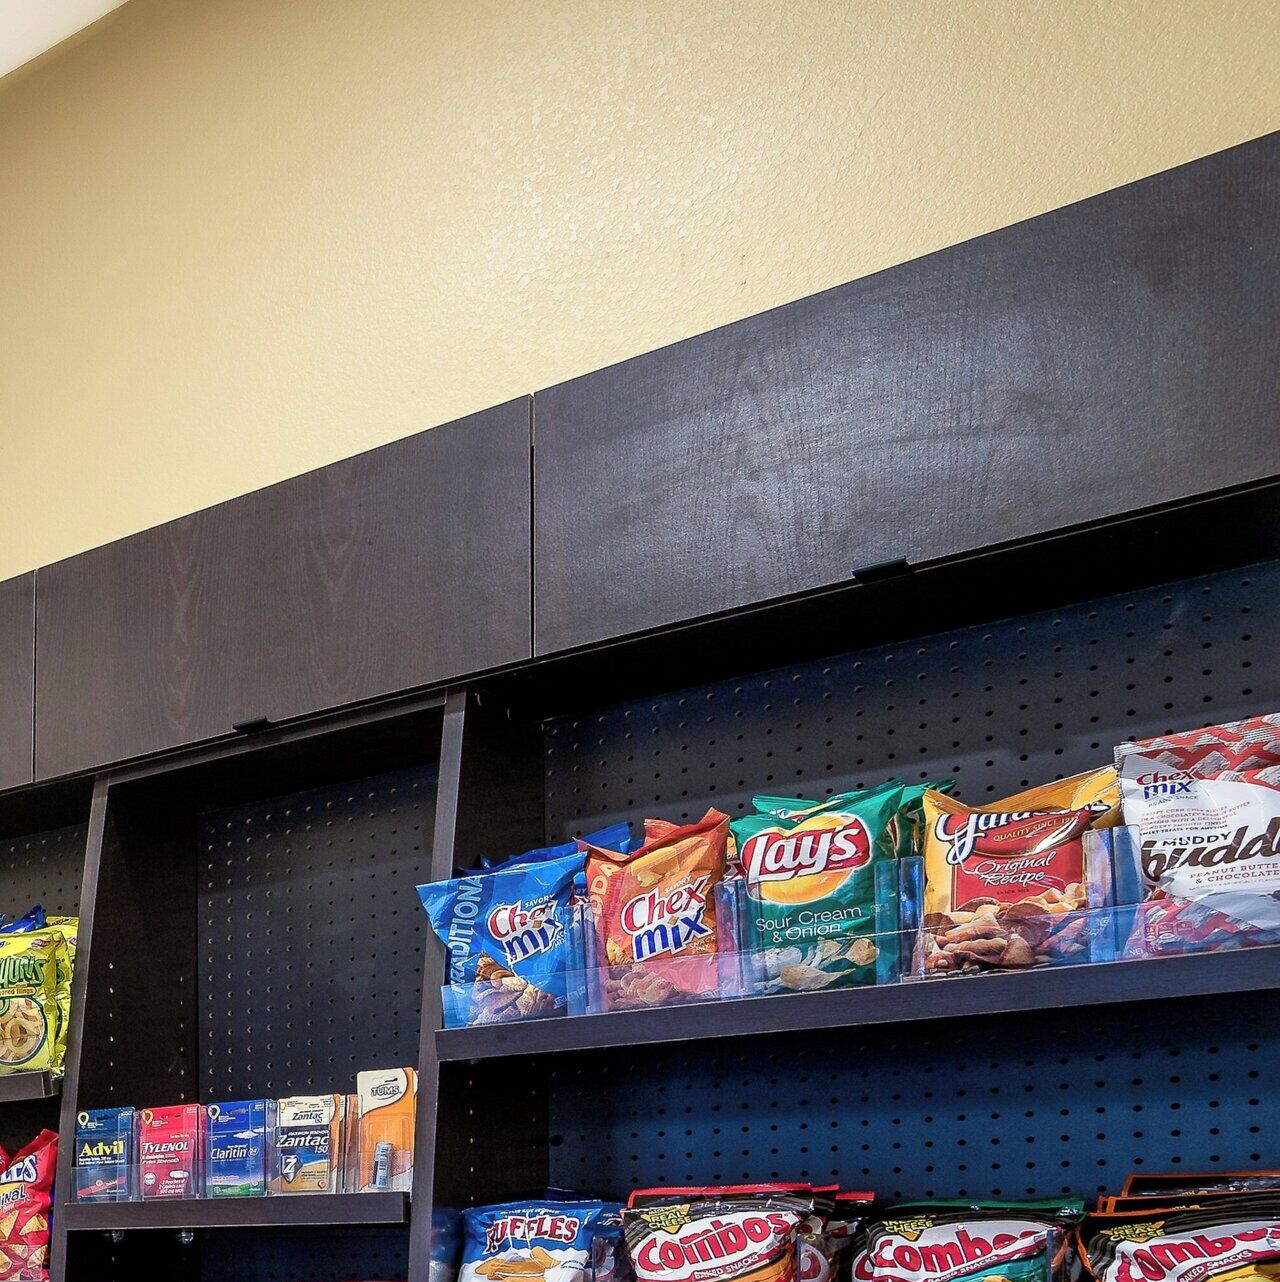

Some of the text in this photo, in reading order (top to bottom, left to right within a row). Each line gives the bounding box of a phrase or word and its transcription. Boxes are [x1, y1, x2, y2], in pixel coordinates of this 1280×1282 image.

[1136, 769, 1196, 785] Chex
[1144, 781, 1193, 799] mix
[1163, 831, 1231, 847] MUDDY
[747, 824, 862, 886] Lay's
[976, 851, 1057, 875] Original
[981, 871, 1046, 886] Recipe
[1190, 865, 1237, 878] PEANUT
[663, 875, 692, 895] SAVORY
[525, 893, 556, 908] SAVORY
[621, 874, 711, 933] Chex
[488, 900, 557, 940] Che
[756, 905, 862, 932] Sour Cream
[634, 911, 713, 962] mix
[772, 922, 842, 943] & Onion
[371, 1085, 400, 1096] TUMS
[292, 1112, 324, 1122] Zantac
[79, 1140, 125, 1157] Advil
[142, 1141, 189, 1154] TYLENOL
[275, 1133, 329, 1148] Zantac
[210, 1148, 247, 1160] Claritin
[648, 1216, 692, 1228] CHEESE
[649, 1210, 685, 1222] REAL
[485, 1215, 581, 1253] RUFFLES
[884, 1220, 933, 1233] CHEESE
[1113, 1226, 1155, 1236] REAL
[637, 1213, 793, 1273] Combos
[1207, 1250, 1252, 1271] SNACKS
